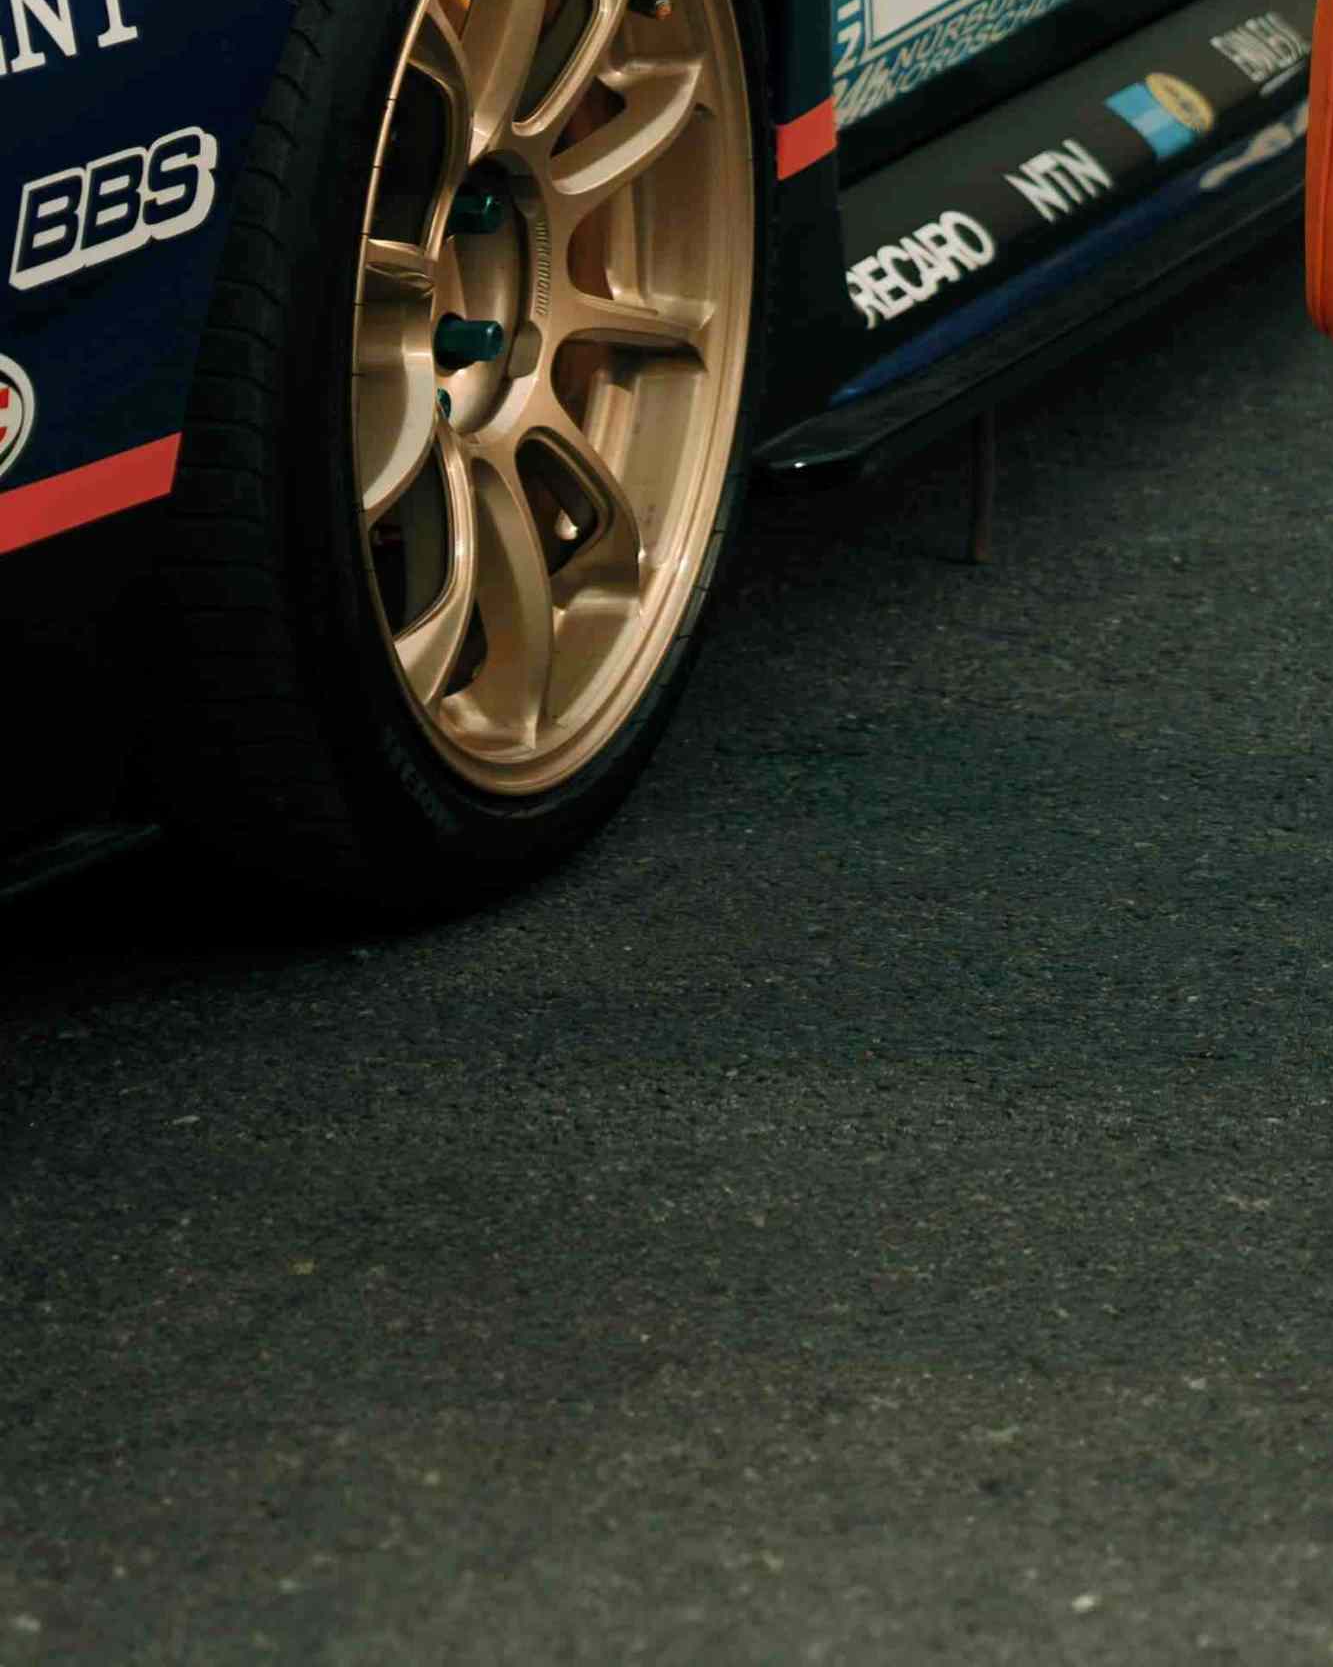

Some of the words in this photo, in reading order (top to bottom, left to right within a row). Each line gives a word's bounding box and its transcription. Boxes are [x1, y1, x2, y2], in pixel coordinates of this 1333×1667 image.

[9, 126, 217, 291] BBS
[1003, 138, 1113, 223] NTN
[845, 210, 996, 330] RECARO
